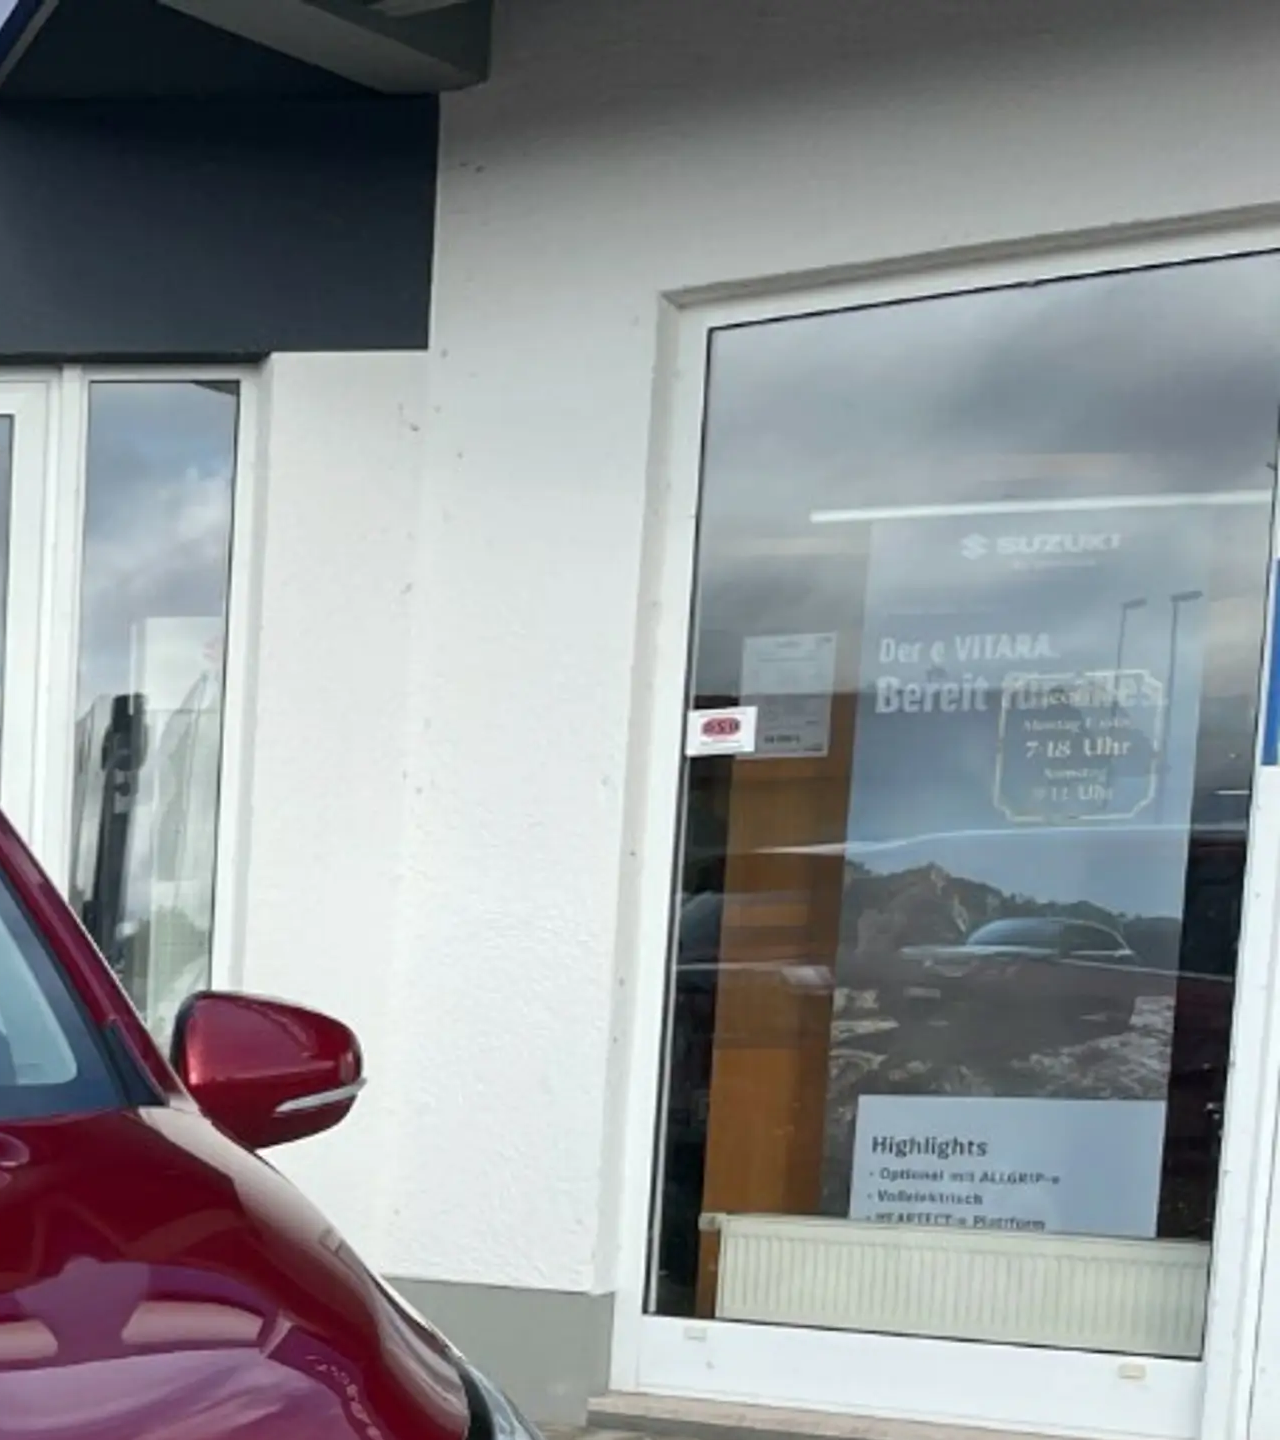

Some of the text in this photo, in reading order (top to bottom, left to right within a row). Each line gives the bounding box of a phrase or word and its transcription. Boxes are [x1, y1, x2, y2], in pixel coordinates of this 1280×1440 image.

[996, 533, 1121, 554] SUZUKI
[878, 637, 924, 664] Der
[929, 640, 946, 664] e
[875, 672, 990, 714] Bereit
[1083, 736, 1133, 757] Uhr
[1078, 784, 1114, 801] Uhr
[871, 1136, 988, 1160] Highlights
[879, 1167, 944, 1185] Optional
[877, 1189, 984, 1206] Vollelektrisch
